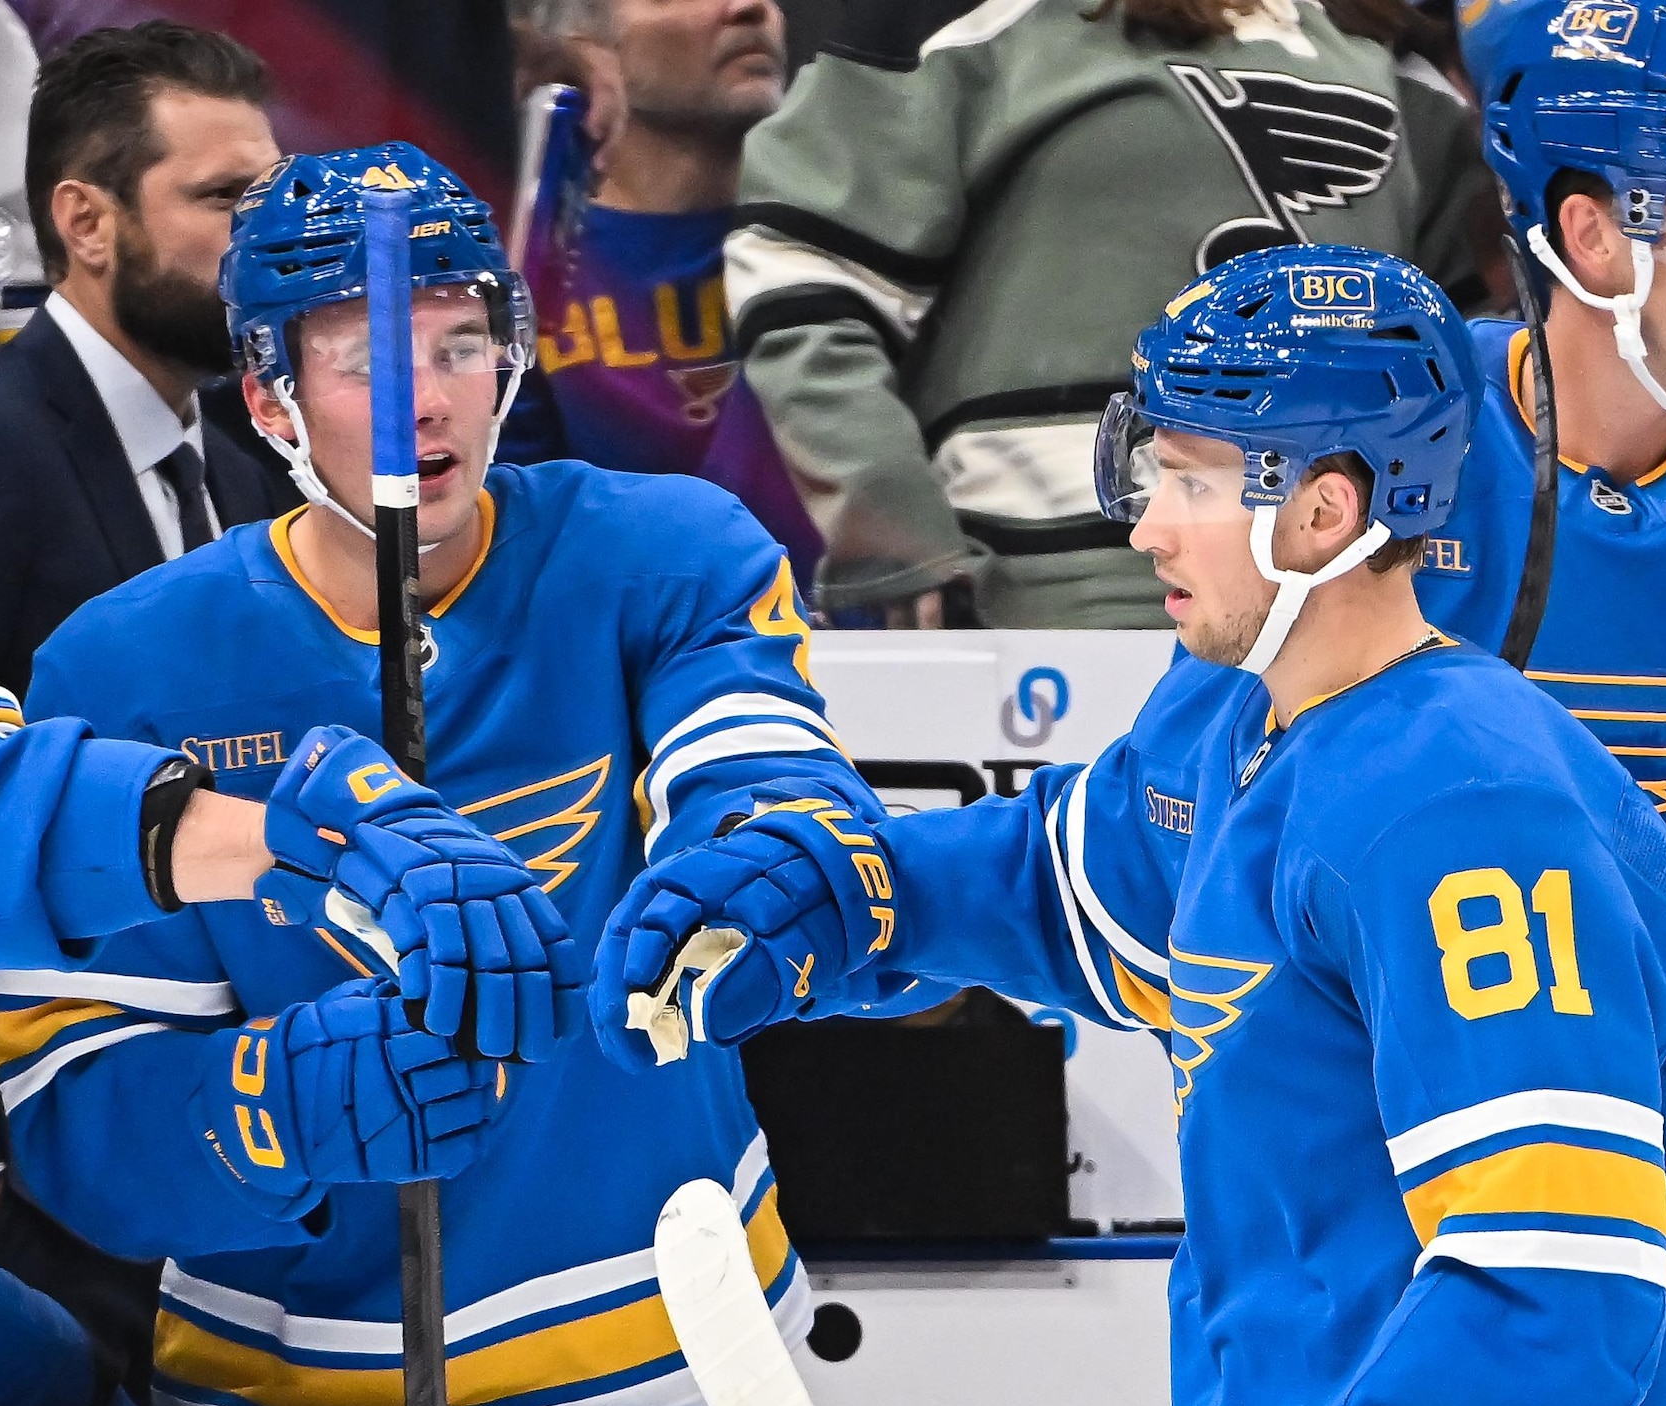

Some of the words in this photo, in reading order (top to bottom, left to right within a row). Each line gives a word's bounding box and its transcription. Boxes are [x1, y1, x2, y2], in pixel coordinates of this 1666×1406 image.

[1301, 275, 1363, 304] BJC
[180, 732, 288, 772] STIFEL
[1428, 867, 1595, 1020] 81
[232, 1016, 286, 1169] CC
